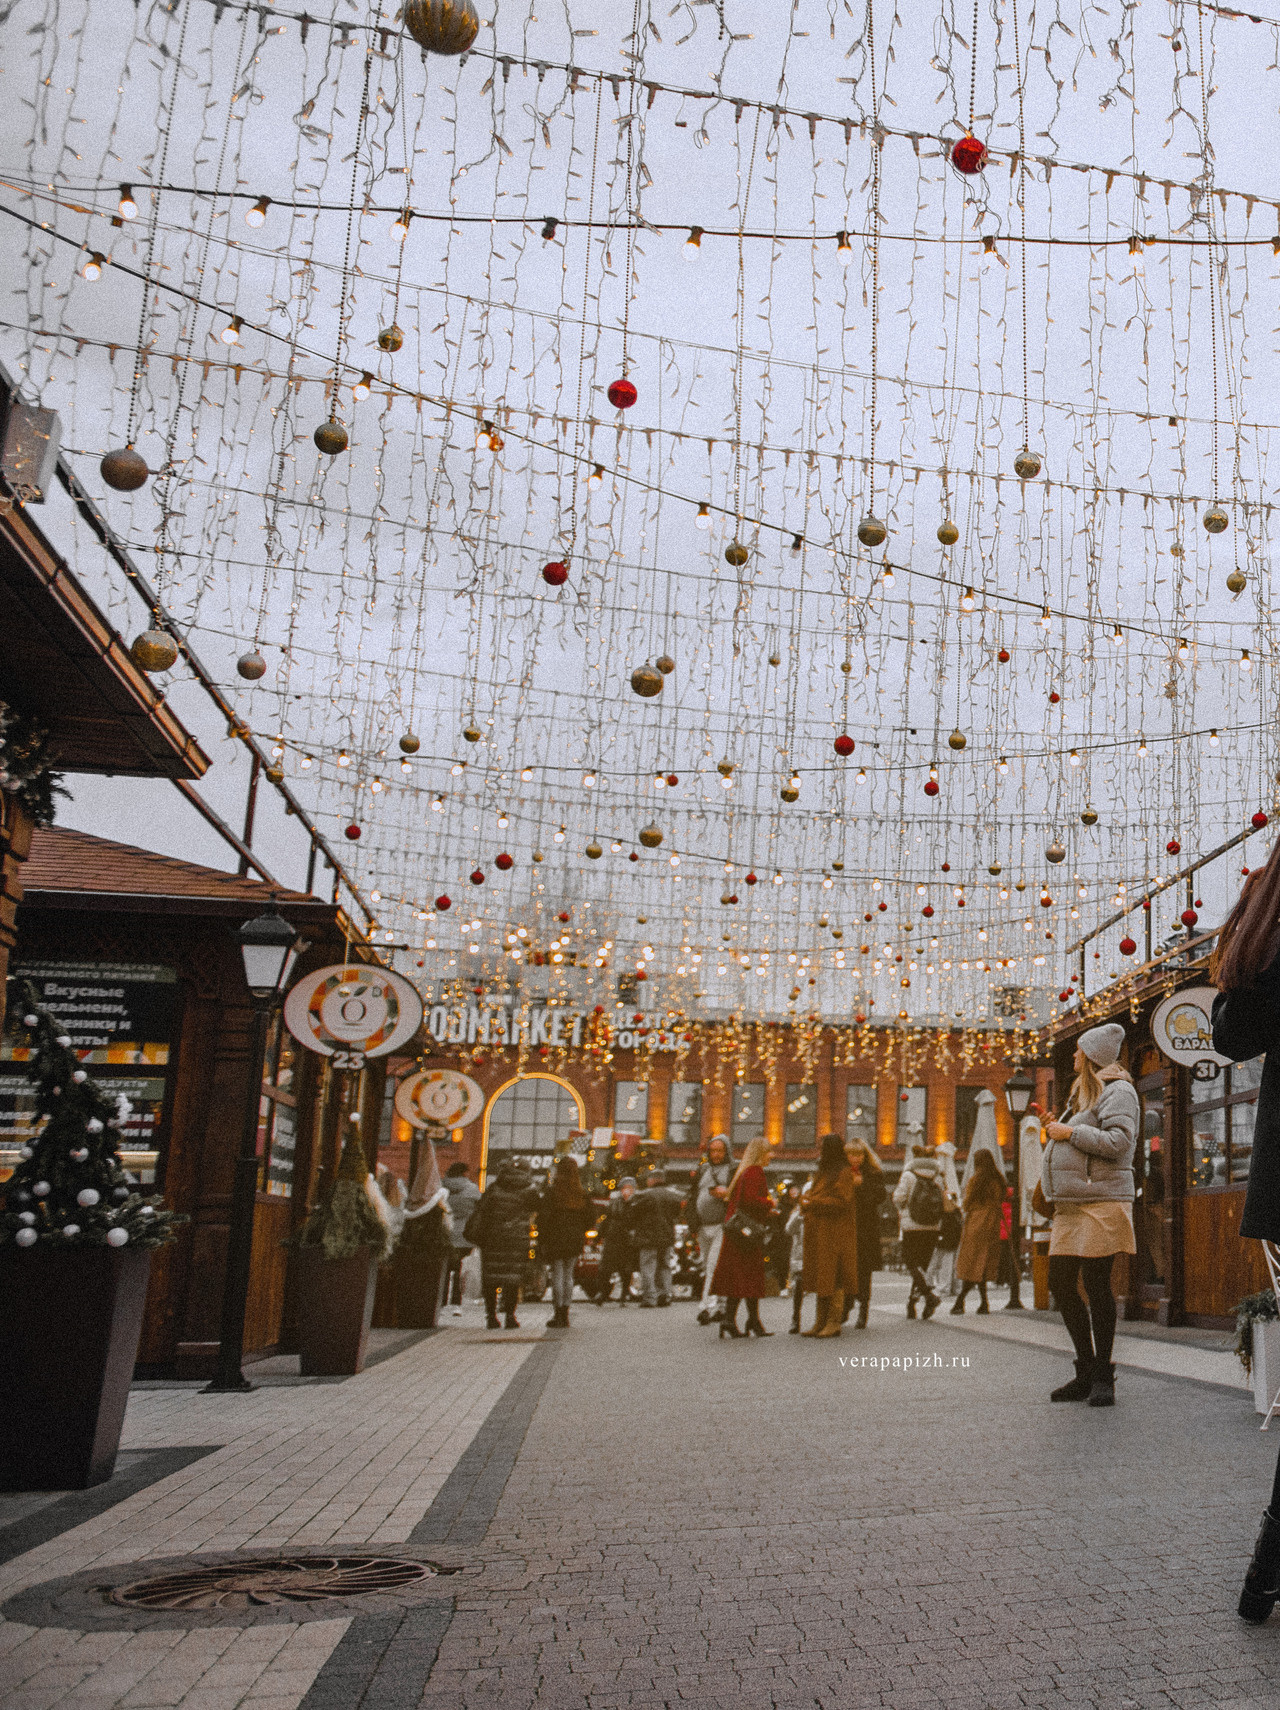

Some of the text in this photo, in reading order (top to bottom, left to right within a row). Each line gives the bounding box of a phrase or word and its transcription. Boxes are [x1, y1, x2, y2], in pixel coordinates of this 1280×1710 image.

[44, 983, 125, 999] Вкусные
[119, 1020, 131, 1030] и
[424, 1005, 587, 1047] ODMARKET
[72, 1036, 109, 1046] нты
[1174, 1037, 1216, 1050] БАРА
[332, 1051, 365, 1069] 23
[1196, 1062, 1216, 1079] 31
